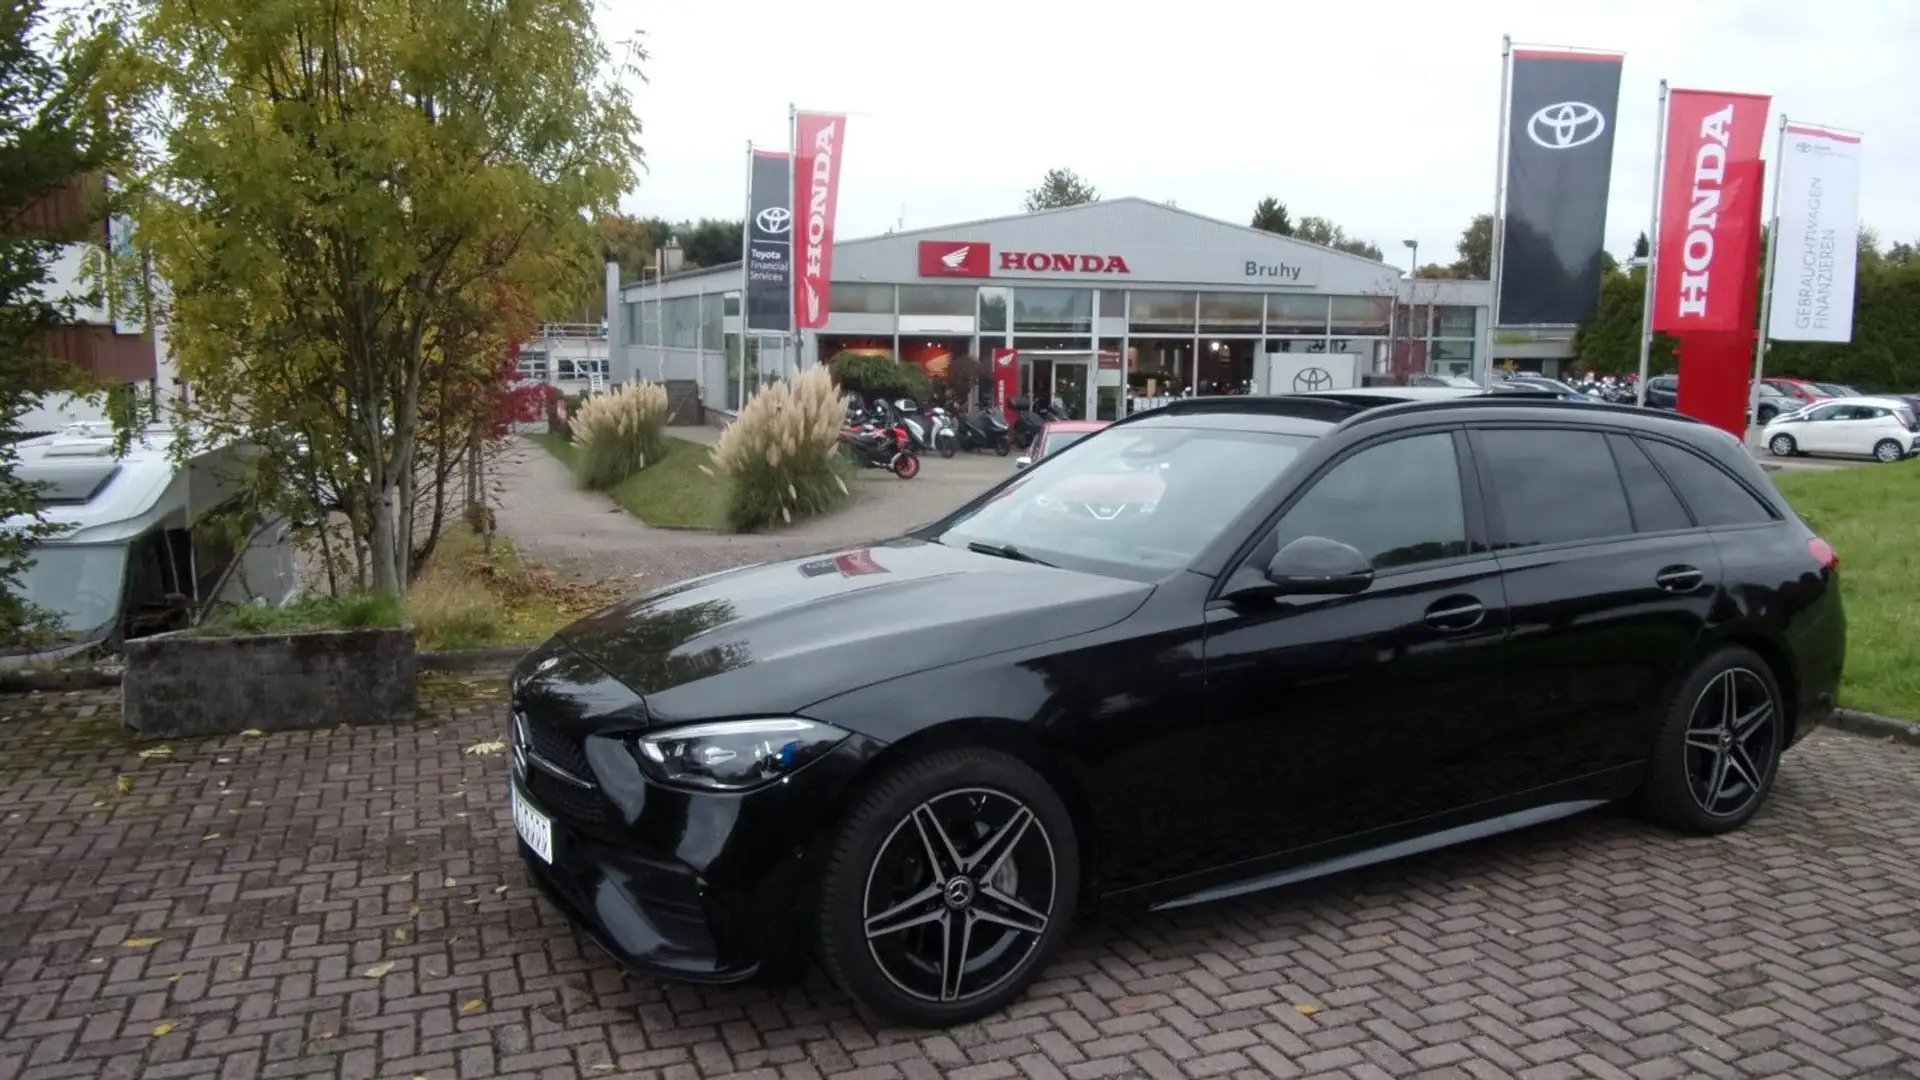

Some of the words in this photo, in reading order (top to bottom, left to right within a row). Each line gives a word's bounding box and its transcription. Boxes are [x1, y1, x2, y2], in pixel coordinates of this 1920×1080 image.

[807, 120, 836, 277] HONDA
[1679, 104, 1734, 318] HONDA
[751, 249, 781, 260] Toyota
[998, 251, 1130, 274] HONDA
[1795, 177, 1822, 330] GEBRAUCHTWAGEN
[750, 260, 788, 272] Financial
[750, 271, 784, 281] Services
[1244, 260, 1302, 280] Bruhy
[1814, 229, 1836, 330] FINANZIEREN
